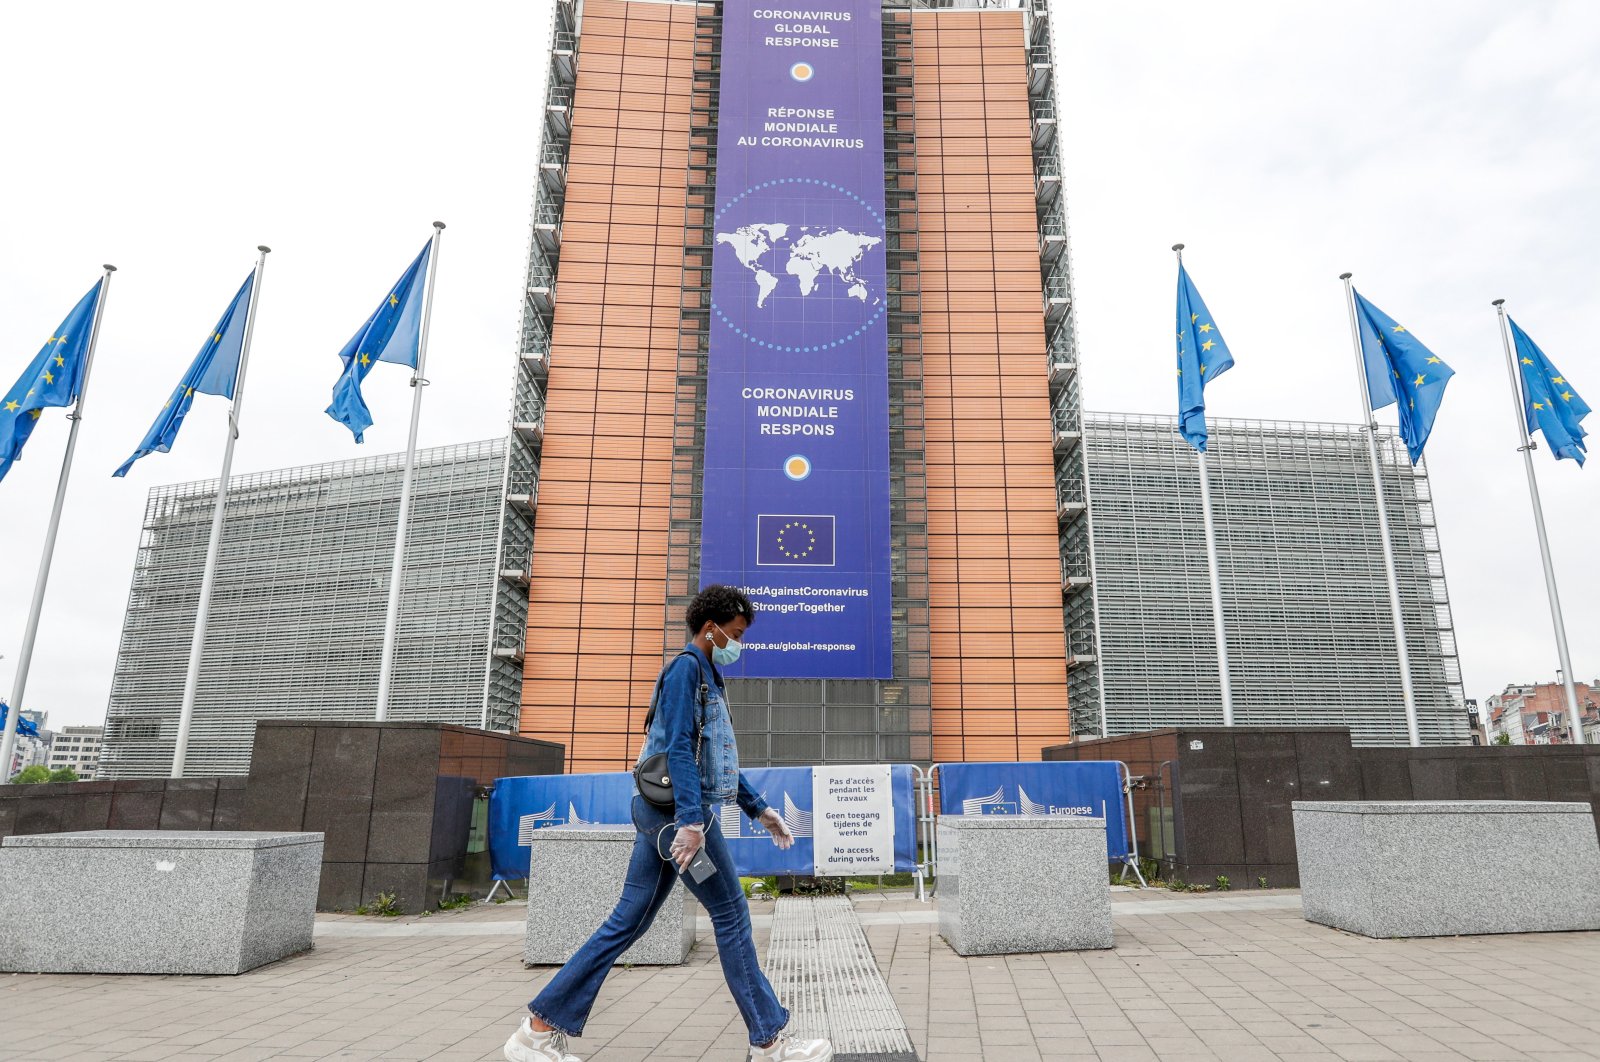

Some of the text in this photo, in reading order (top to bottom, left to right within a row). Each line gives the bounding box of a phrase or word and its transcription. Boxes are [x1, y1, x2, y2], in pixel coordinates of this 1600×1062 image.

[753, 9, 852, 22] CORONAVIRUS
[774, 23, 831, 34] GLOBAL
[765, 36, 839, 48] RESPONSE
[767, 106, 835, 119] RÉPONSE
[764, 122, 838, 134] MONDIALE
[736, 136, 864, 149] AU CORONAVIRUS
[741, 387, 854, 401] CORONAVIRUS
[757, 405, 838, 418] MONDIALE
[760, 423, 835, 436] RESPONS
[724, 585, 869, 599] nitedAgainstCoronavirus
[751, 601, 846, 614] StrongerTogether
[741, 641, 856, 652] uropa.eu/global-response
[845, 776, 875, 785] d'accès
[829, 785, 875, 795] pendant les
[1049, 804, 1093, 815] Europese
[825, 812, 880, 820] Geen toegang
[833, 820, 873, 829] tijdens de
[838, 829, 868, 837] werken
[833, 846, 845, 854] No
[828, 854, 880, 864] during works
